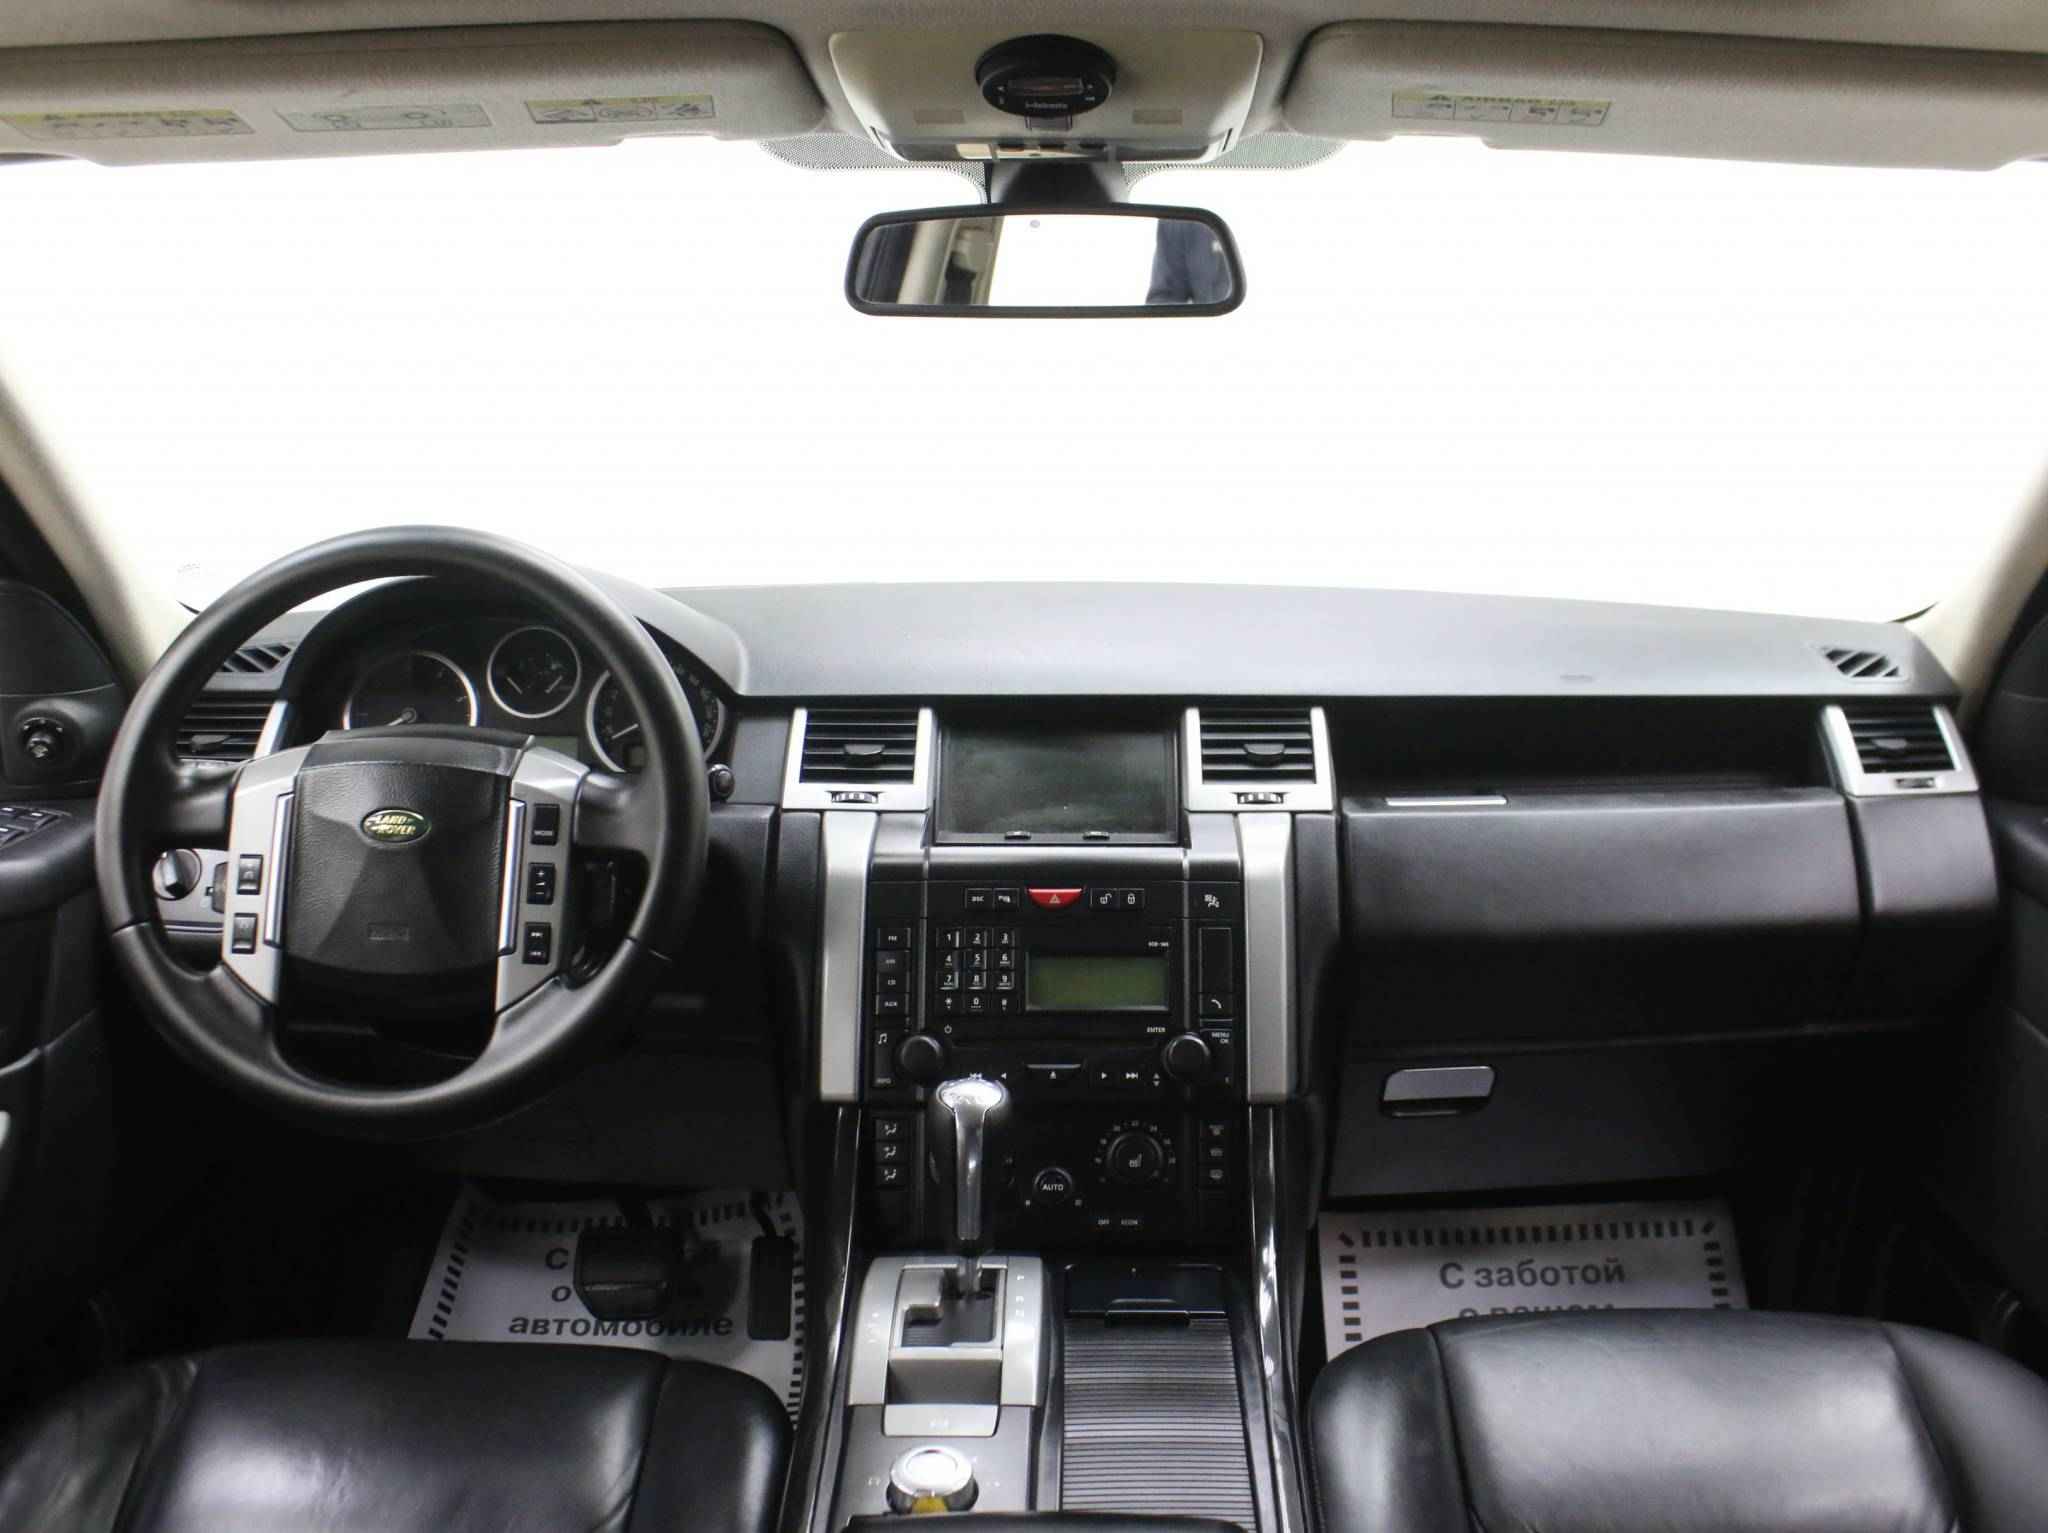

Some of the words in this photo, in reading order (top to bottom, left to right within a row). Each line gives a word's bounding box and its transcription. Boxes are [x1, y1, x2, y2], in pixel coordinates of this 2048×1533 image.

[376, 814, 406, 825] LAND
[376, 824, 416, 835] ROVER
[1041, 1183, 1065, 1192] AUTO
[1439, 1262, 1465, 1289] С
[1474, 1257, 1626, 1288] заботой
[508, 1314, 734, 1337] автомобиле
